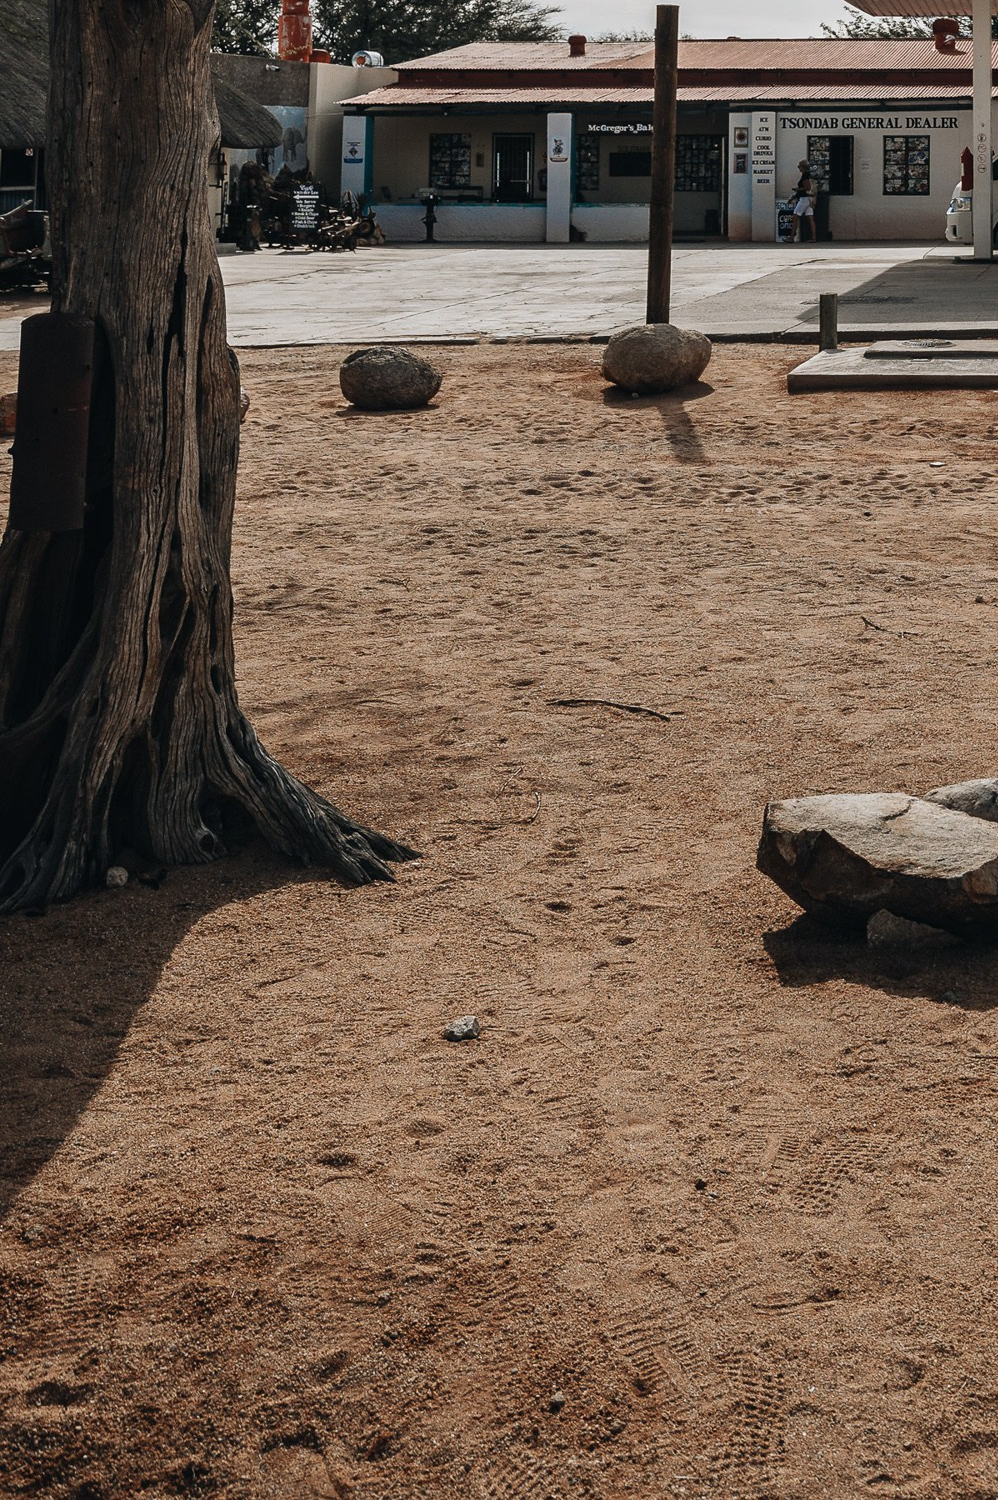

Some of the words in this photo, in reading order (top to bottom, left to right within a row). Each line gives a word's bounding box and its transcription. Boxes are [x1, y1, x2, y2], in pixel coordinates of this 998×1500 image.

[780, 117, 838, 129] TSONDAB
[841, 117, 902, 129] GENERAL
[905, 117, 959, 129] DEALER
[588, 124, 634, 134] McGregor's
